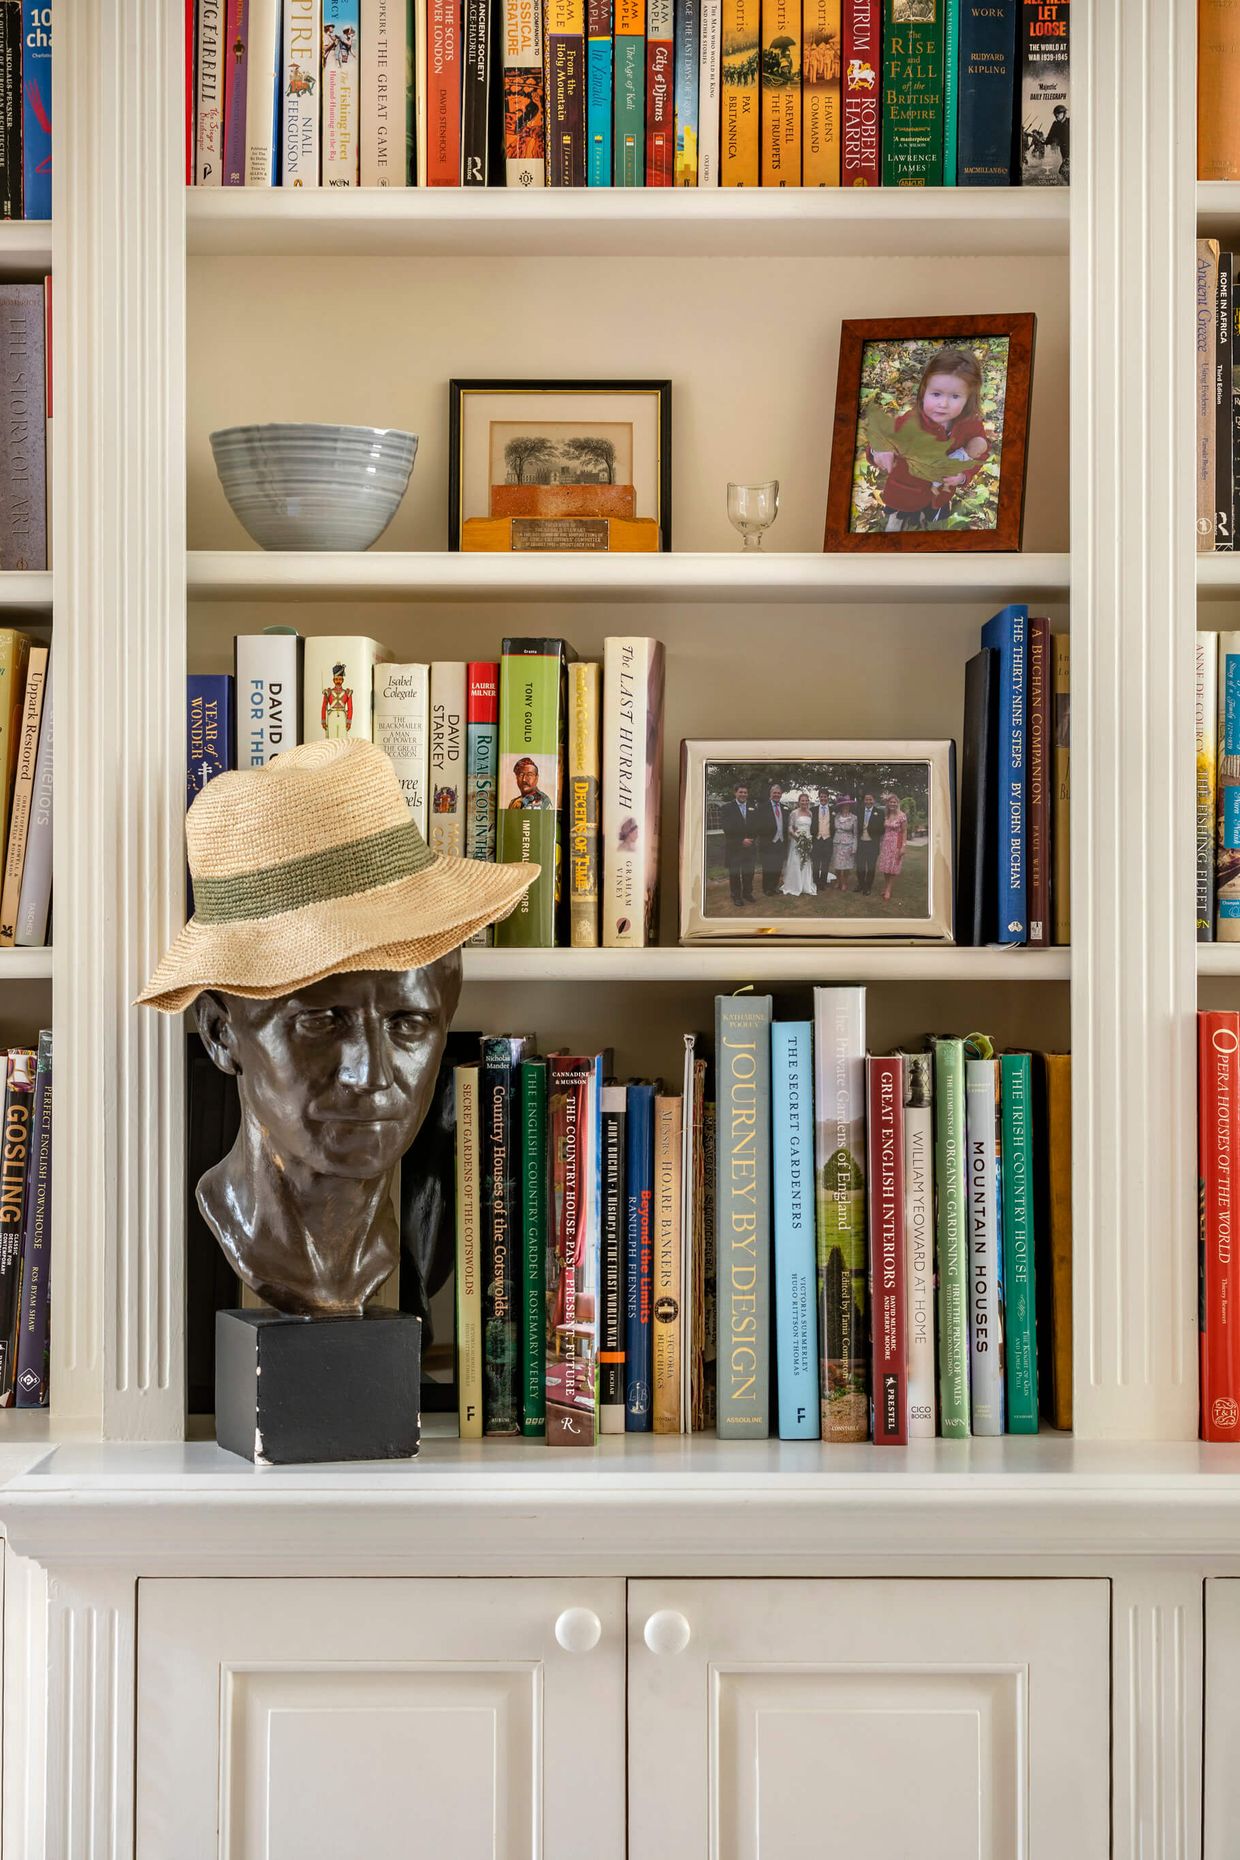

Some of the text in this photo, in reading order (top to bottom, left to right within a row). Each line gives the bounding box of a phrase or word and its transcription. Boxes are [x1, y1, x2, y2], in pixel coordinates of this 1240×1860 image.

[907, 31, 922, 40] The
[971, 8, 1005, 18] WORK
[1029, 22, 1067, 37] LOOSE
[1038, 5, 1058, 20] LET
[567, 51, 576, 96] From the
[889, 61, 937, 79] FALL
[891, 38, 936, 55] RISE
[907, 55, 921, 65] and
[968, 65, 1006, 75] KIPLING
[970, 53, 1005, 62] RUDYARD
[1028, 53, 1068, 62] WAR 1939-1945
[1029, 43, 1067, 51] THE WORLD AT
[377, 40, 388, 167] THE GREAT GAME
[556, 44, 566, 121] Holy Mountain
[742, 96, 751, 114] PAX
[887, 90, 939, 105] BRITISH
[902, 82, 926, 92] of the
[1030, 93, 1067, 101] DAILY TELEGRAPH
[288, 100, 299, 173] FERGUSON
[302, 116, 313, 157] NIALL
[728, 96, 737, 160] BRITANNICA
[771, 94, 781, 170] THE TRUMPETS
[785, 94, 794, 144] FAREWELL
[810, 96, 820, 154] COMMAND
[824, 96, 833, 143] HEAVEN'S
[845, 98, 861, 170] HARRIS
[861, 98, 876, 171] ROBERT
[889, 106, 936, 120] EMPIRE
[887, 154, 938, 163] LAWRENCE
[897, 164, 927, 173] JAMES
[10, 317, 27, 358] THE
[10, 372, 29, 448] STORY
[11, 456, 28, 482] OF
[11, 494, 30, 538] ART
[383, 687, 418, 701] Colegate
[388, 675, 413, 687] Isabel
[20, 672, 43, 781] Uppark Restored
[190, 697, 203, 760] WONDER
[203, 700, 218, 758] YEAR of
[250, 680, 264, 766] FOR THE
[268, 683, 284, 744] DAVID
[378, 722, 422, 731] BLACKMAILER
[432, 704, 445, 771] STARKEY
[447, 714, 461, 762] DAVID
[524, 682, 534, 743] TONY GOULD
[618, 645, 635, 810] The LAST HURRAH
[1010, 616, 1025, 889] THE THIRTY-NINE STEPS BY JOHN BUCHAN
[616, 867, 624, 899] VINEY
[485, 1055, 511, 1063] Nicholas
[788, 1036, 802, 1230] THE SECRET GARDENERS
[832, 1006, 851, 1232] The Private Gardens of England
[1212, 1028, 1239, 1265] OPERA HOUSES OF THE WORLD
[0, 1104, 29, 1223] GOSLING
[463, 1084, 474, 1296] SECRET GARDENS OF THE COTSWOLDS
[881, 1071, 896, 1289] GREAT ENGLISH INTERIORS
[1012, 1069, 1027, 1283] THE IRISH COUNTRY HOUSE
[28, 1086, 52, 1332] PERFECT ENGLISH TOWNHOUSE ROS BYAM SHAW
[490, 1085, 509, 1317] Country Houses of the Cotswolds
[660, 1110, 673, 1288] MESSRS HOARE BANKERS
[722, 1036, 757, 1401] JOURNEY BY DESIGN
[527, 1072, 540, 1400] THE ENGLISH COUNTRY GARDEN ROSEMARY VEREY
[627, 1196, 638, 1319] RANULPH FIENNES
[639, 1190, 653, 1325] Beyond the Limits
[912, 1130, 927, 1345] WILLIAM YEOWARD AT HOME
[973, 1141, 988, 1353] MOUNTAIN HOUSES
[800, 1276, 809, 1373] VICTORIA SUMMERLEY
[839, 1271, 851, 1380] Edited by Tania Compton
[657, 1334, 665, 1389] HUTCHINGS
[667, 1334, 676, 1379] VICTORIA
[726, 1416, 763, 1424] ASSOULINE
[887, 1388, 896, 1430] PRESTEL
[910, 1406, 932, 1414] CICO
